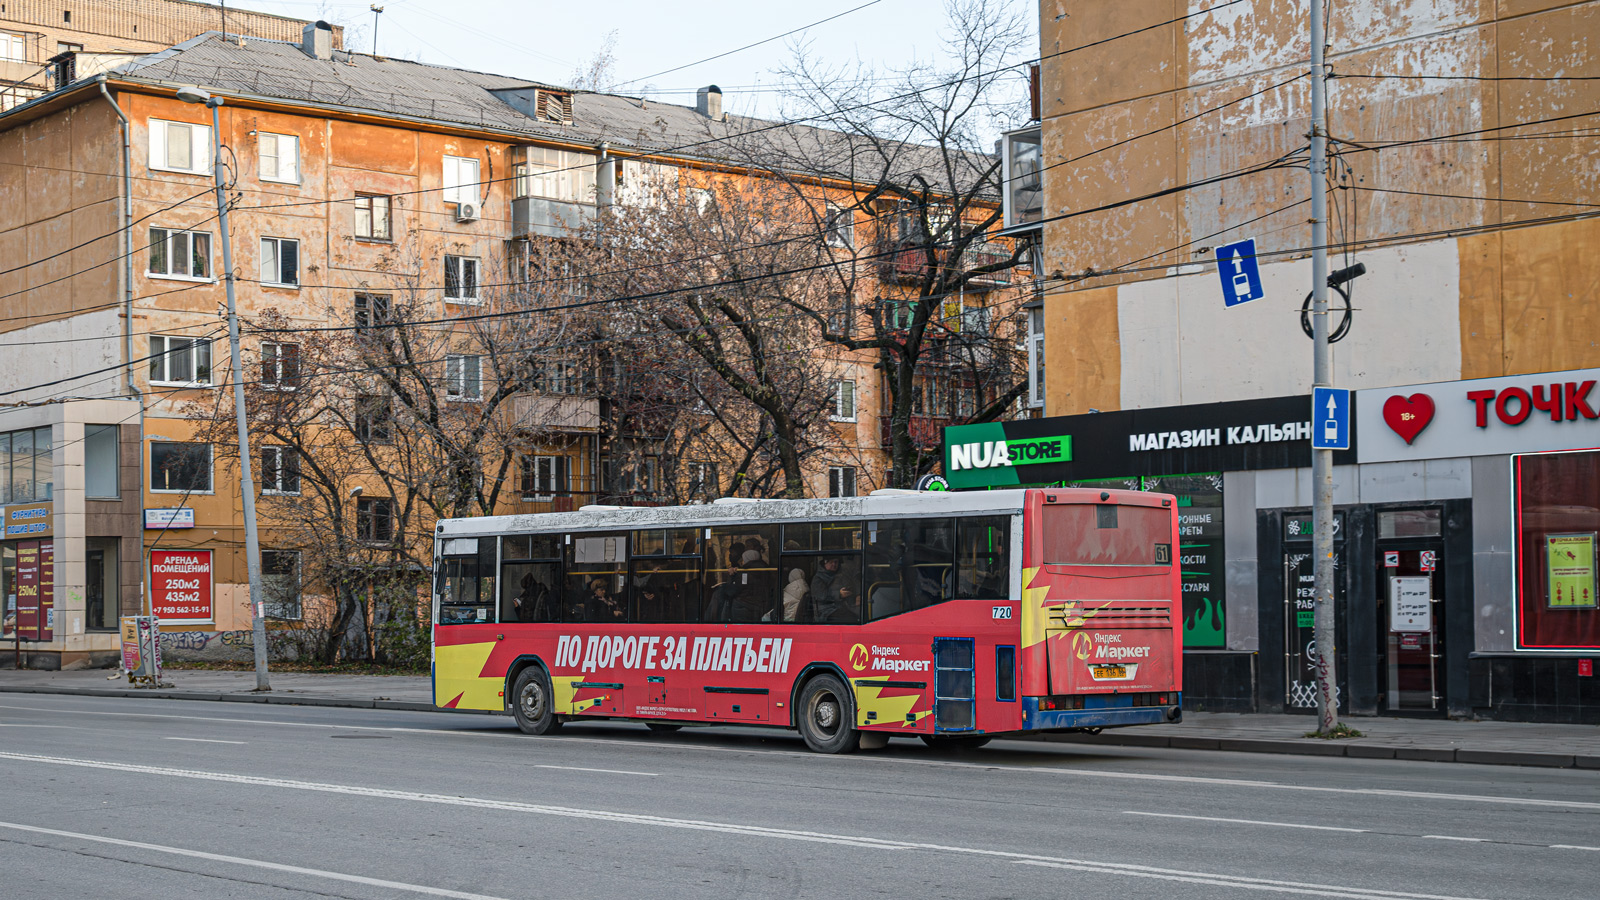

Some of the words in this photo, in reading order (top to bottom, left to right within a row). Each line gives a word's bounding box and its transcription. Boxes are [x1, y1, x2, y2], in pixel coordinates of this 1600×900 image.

[1467, 380, 1600, 429] ТОЧК
[1401, 412, 1416, 421] 18+
[1129, 428, 1221, 452] МАГАЗИН
[1227, 421, 1314, 445] КАЛЬЯН
[951, 440, 1012, 471] NUA
[1007, 440, 1062, 461] STORE
[11, 508, 47, 520] ФУРНИТУРА
[1156, 546, 1168, 561] 61
[164, 556, 199, 565] АРЕНДА
[153, 563, 210, 574] ПОМЕЩЕНИЙ
[165, 579, 200, 590] 250м2
[1181, 583, 1210, 592] СУАРЫ
[18, 585, 37, 596] 250м2
[1296, 588, 1316, 597] РЕЖ
[165, 591, 200, 602] 435м2
[1296, 600, 1316, 609] РАБ
[993, 607, 1012, 618] 720
[1094, 633, 1122, 644] Яндекс
[555, 635, 582, 668] ПО
[581, 635, 660, 673] ДОРОГЕ
[660, 636, 687, 670] ЗА
[689, 636, 793, 673] ПЛАТЬЕМ
[871, 645, 900, 656] Яндекс
[1095, 645, 1151, 660] Маркет
[871, 657, 931, 673] Маркет
